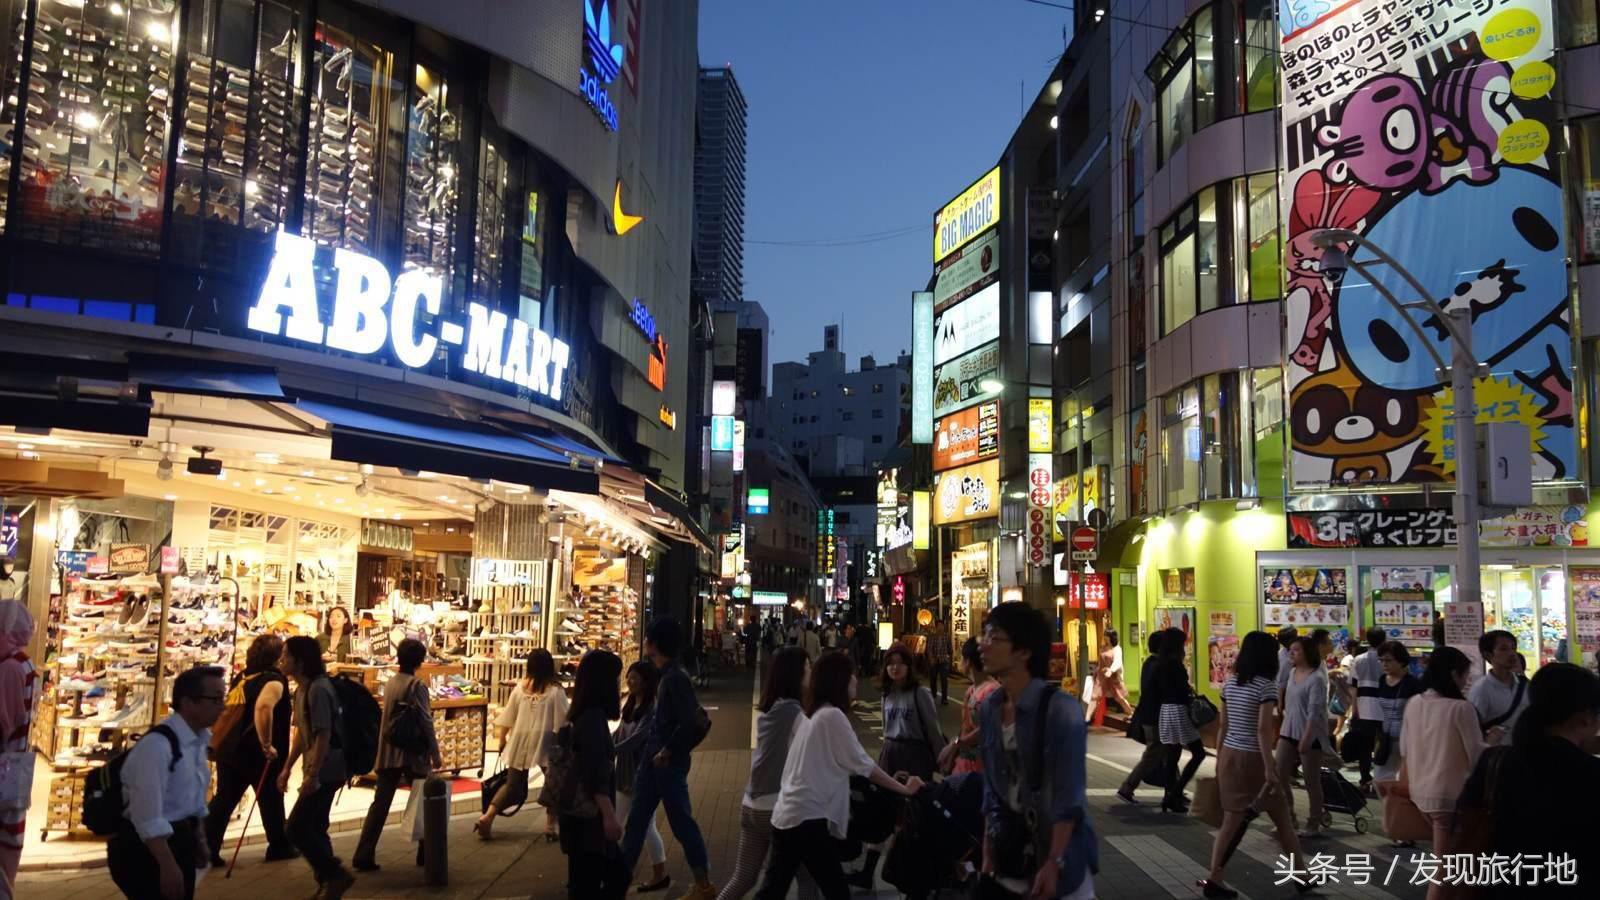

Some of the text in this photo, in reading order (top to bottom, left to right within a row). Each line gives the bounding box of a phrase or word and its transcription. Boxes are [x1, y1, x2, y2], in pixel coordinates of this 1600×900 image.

[1296, 0, 1509, 107] キセキのコラボレーシ
[579, 67, 617, 131] adidas
[1506, 131, 1540, 144] フェイス
[941, 192, 993, 254] BIG MAGIC
[248, 228, 570, 400] ABC-MART
[1031, 469, 1050, 506] 桂花
[1031, 510, 1043, 561] ラーメン
[1317, 516, 1354, 541] 3F
[1358, 511, 1454, 531] クレーンゲー
[1372, 529, 1458, 546] &くじフロ
[1503, 523, 1565, 537] 大量入荷!
[954, 583, 968, 632] 丸水産
